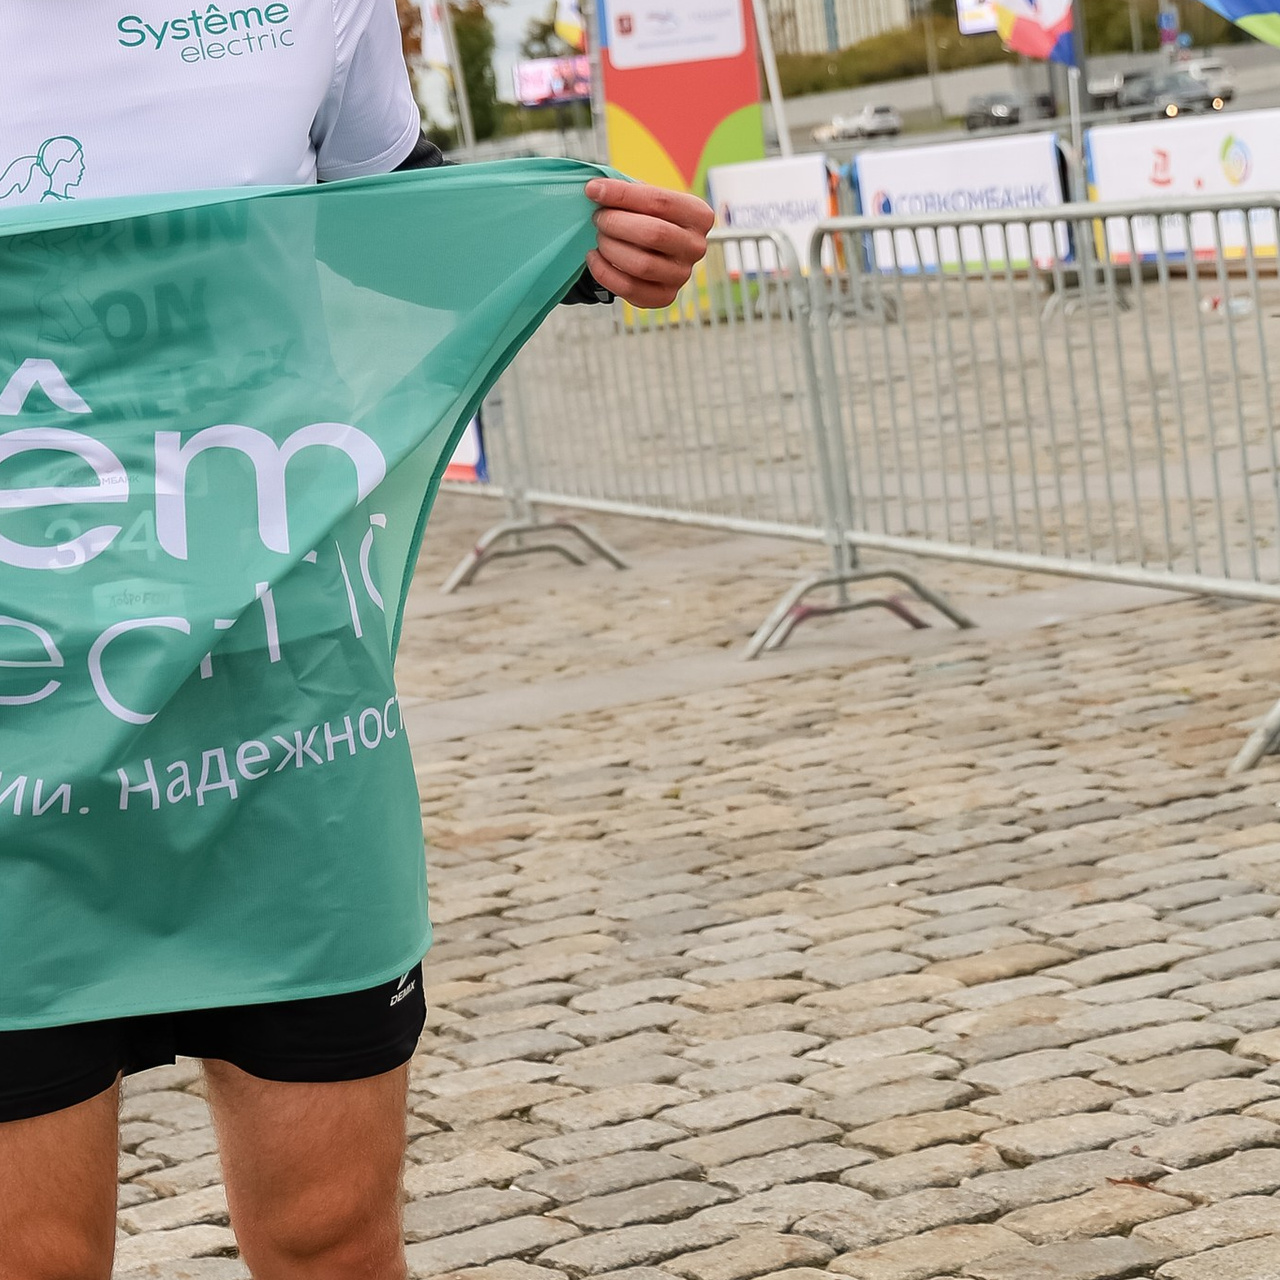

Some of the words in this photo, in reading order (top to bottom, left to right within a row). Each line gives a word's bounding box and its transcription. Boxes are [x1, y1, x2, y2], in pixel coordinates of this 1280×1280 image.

[117, 3, 290, 51] Systême
[180, 28, 295, 63] electric
[389, 979, 416, 1007] DEMIX
